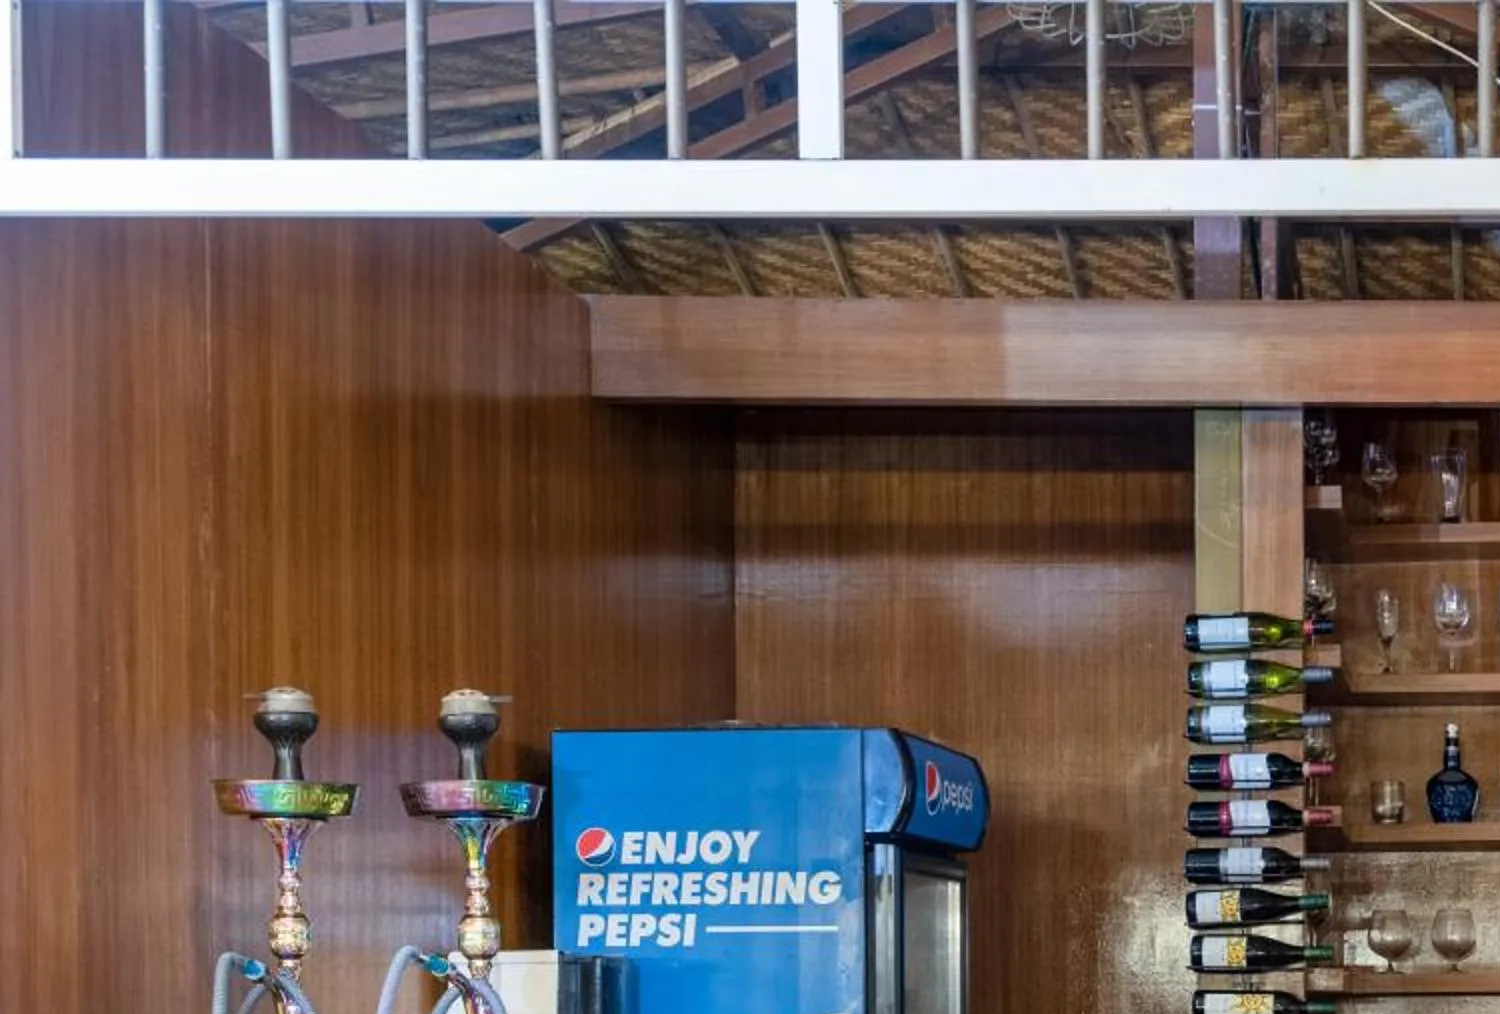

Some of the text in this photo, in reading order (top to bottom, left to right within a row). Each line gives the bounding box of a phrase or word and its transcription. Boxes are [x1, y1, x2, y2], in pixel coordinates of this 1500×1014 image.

[941, 780, 974, 815] pepsi
[621, 831, 760, 865] ENJOY
[577, 871, 842, 906] REFRESHING
[577, 914, 697, 947] PEPSI
